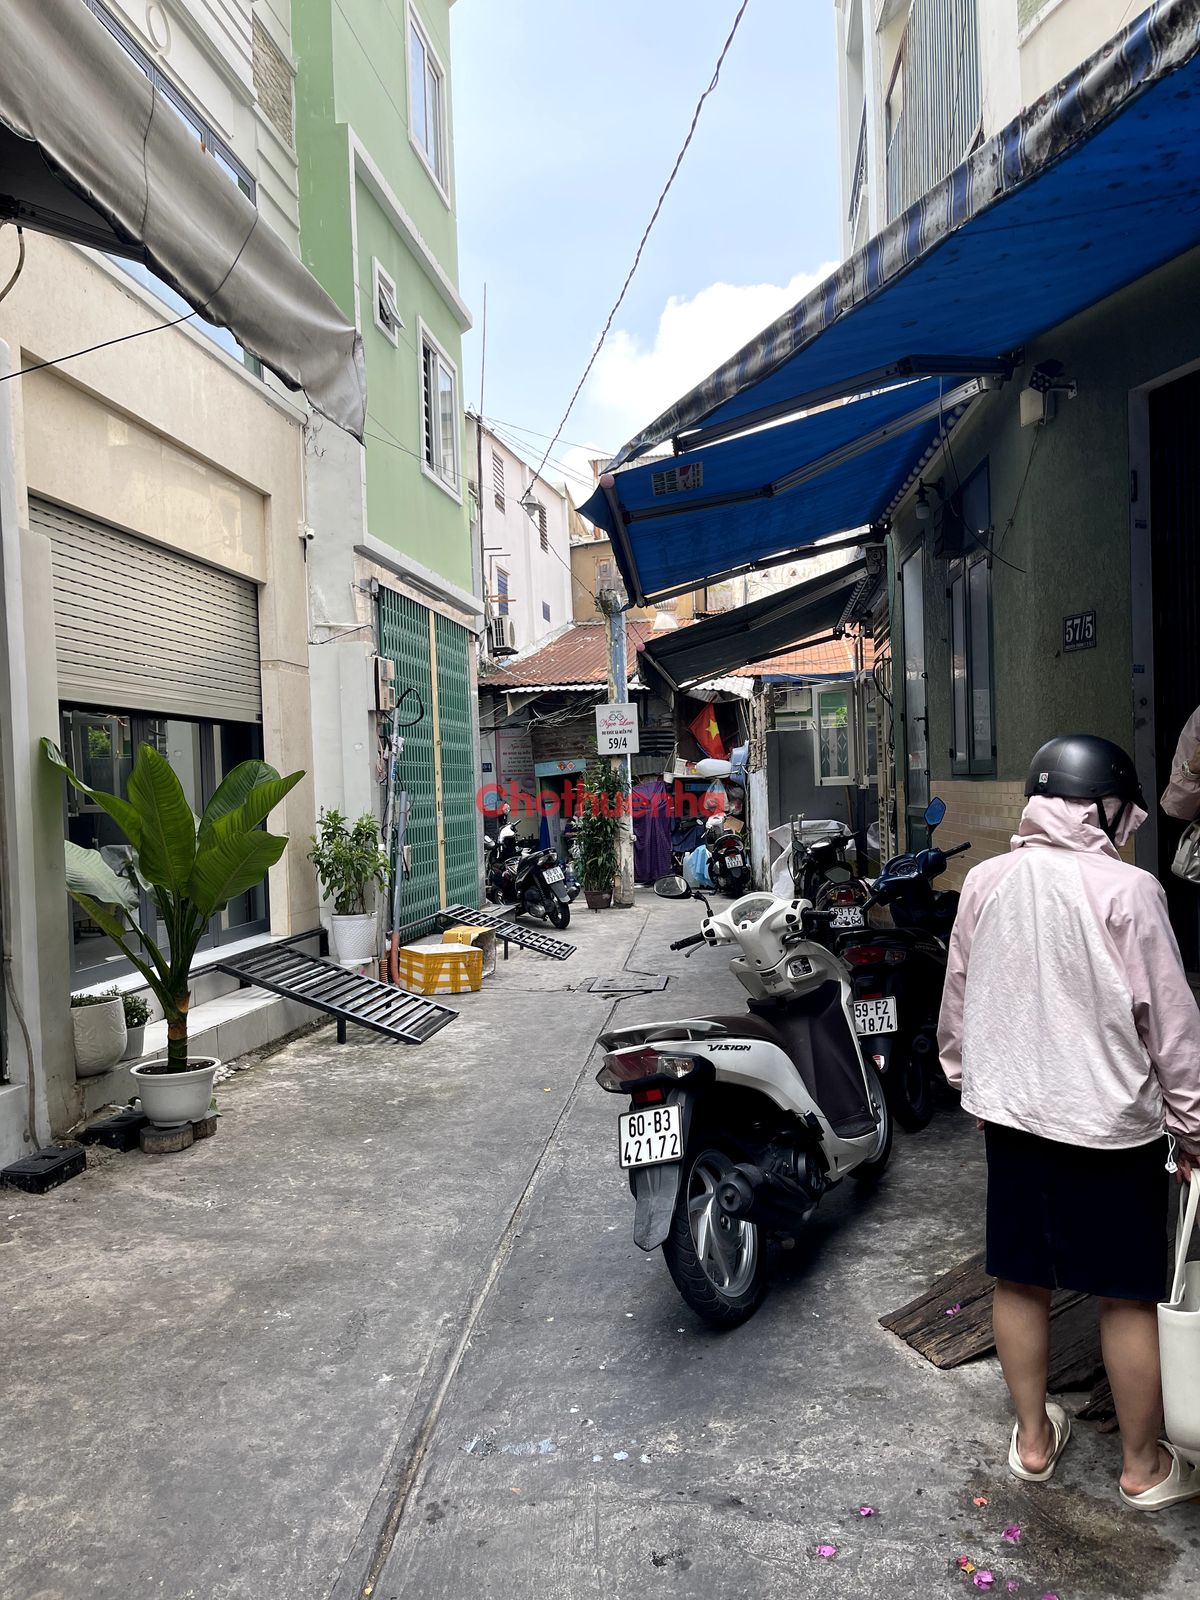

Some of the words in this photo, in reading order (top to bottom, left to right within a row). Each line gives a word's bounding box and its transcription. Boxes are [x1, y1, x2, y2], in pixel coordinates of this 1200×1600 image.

[1065, 615, 1093, 642] 57/5
[608, 737, 627, 749] 59/4
[855, 1001, 889, 1018] 59-F2
[707, 1044, 752, 1052] VISION
[628, 1109, 671, 1138] 60-B3
[624, 1133, 679, 1164] 421.72
